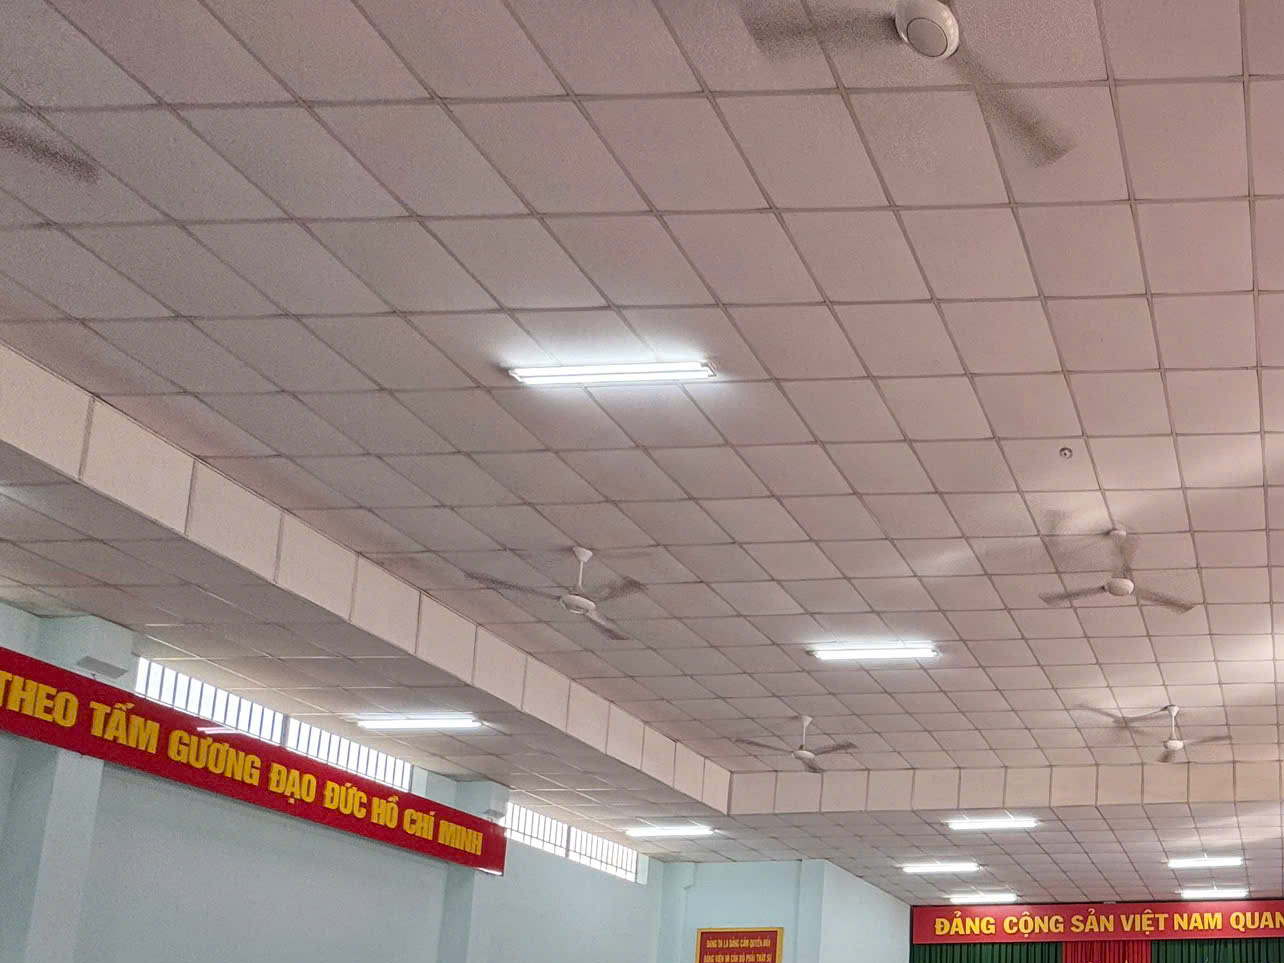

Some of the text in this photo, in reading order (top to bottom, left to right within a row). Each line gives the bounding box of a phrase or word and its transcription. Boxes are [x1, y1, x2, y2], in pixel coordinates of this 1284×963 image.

[90, 701, 161, 754] TẤM
[168, 730, 261, 786] GƯƠNG
[268, 763, 318, 804] ĐẠO
[323, 781, 368, 819] ĐỨC
[371, 795, 400, 829] HỒ
[403, 808, 436, 841] CHÍ
[438, 820, 484, 856] MINH
[934, 910, 996, 936] ĐẢNG
[1003, 911, 1065, 938] CỘNG
[1071, 908, 1115, 933] SẢN
[1120, 909, 1169, 936] VIỆT
[1173, 912, 1223, 931] NAM
